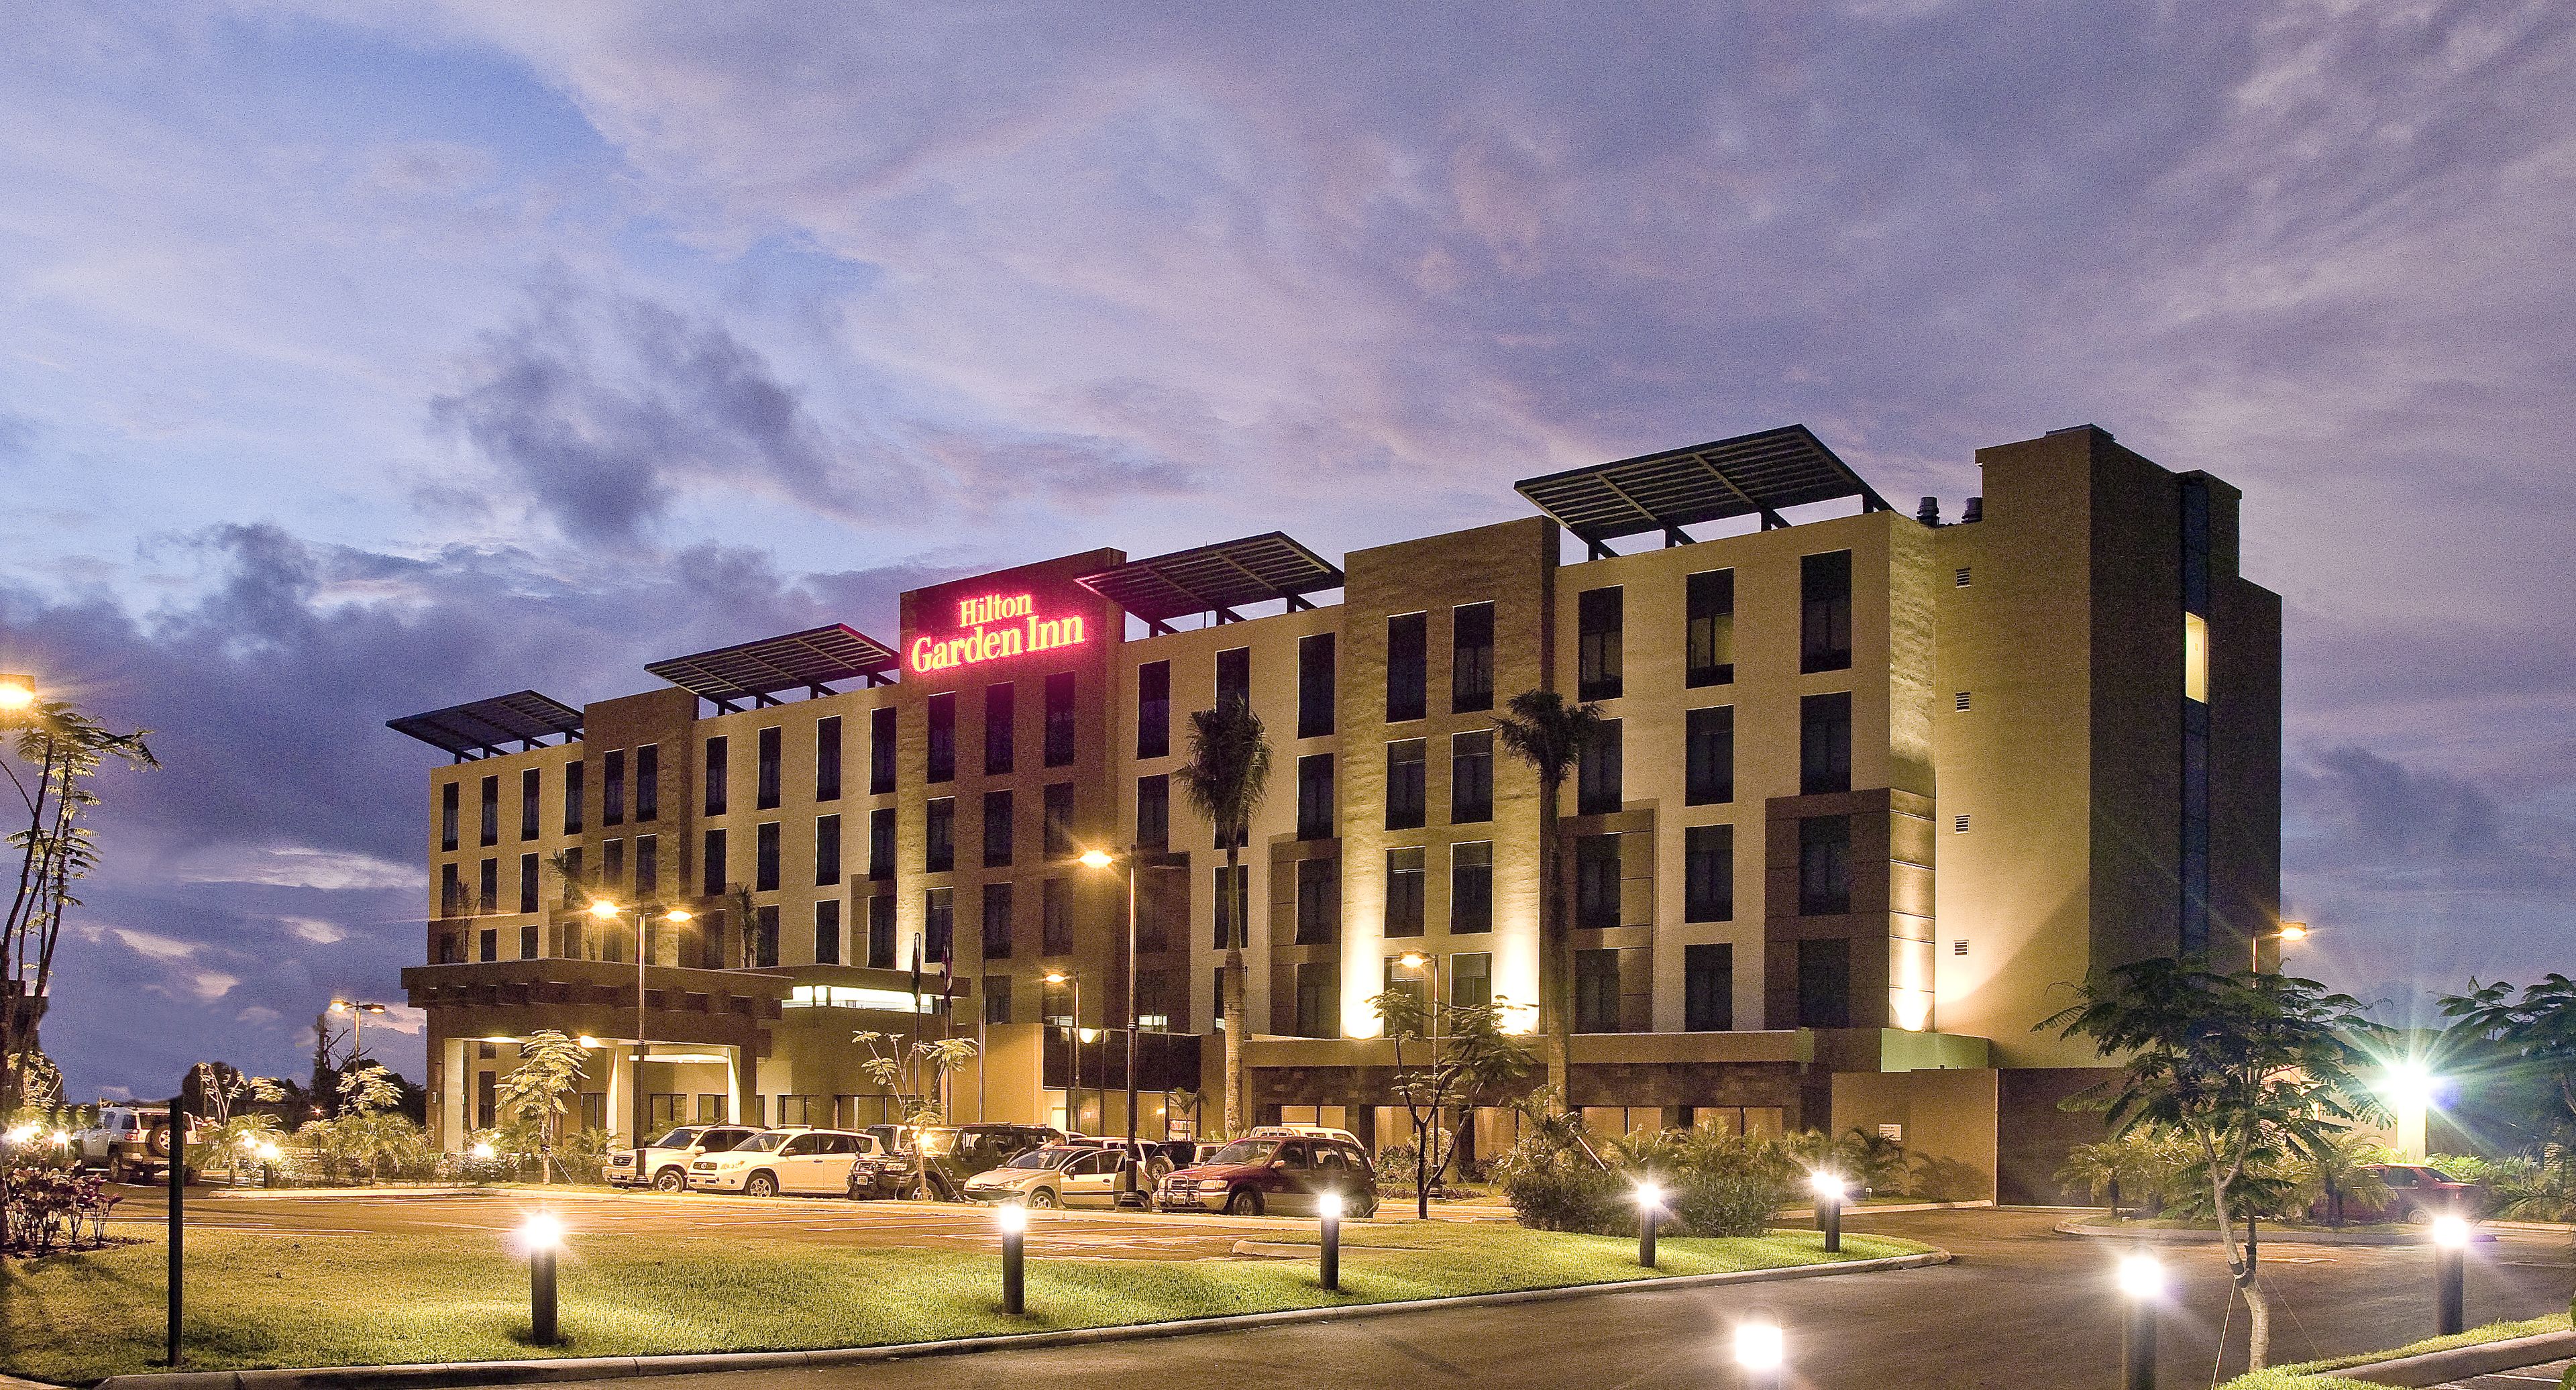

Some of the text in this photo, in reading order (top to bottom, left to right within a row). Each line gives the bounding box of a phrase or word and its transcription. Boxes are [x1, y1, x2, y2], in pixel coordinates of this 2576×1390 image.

[959, 594, 1032, 627] Hilton
[912, 615, 1085, 673] Garden Inn
